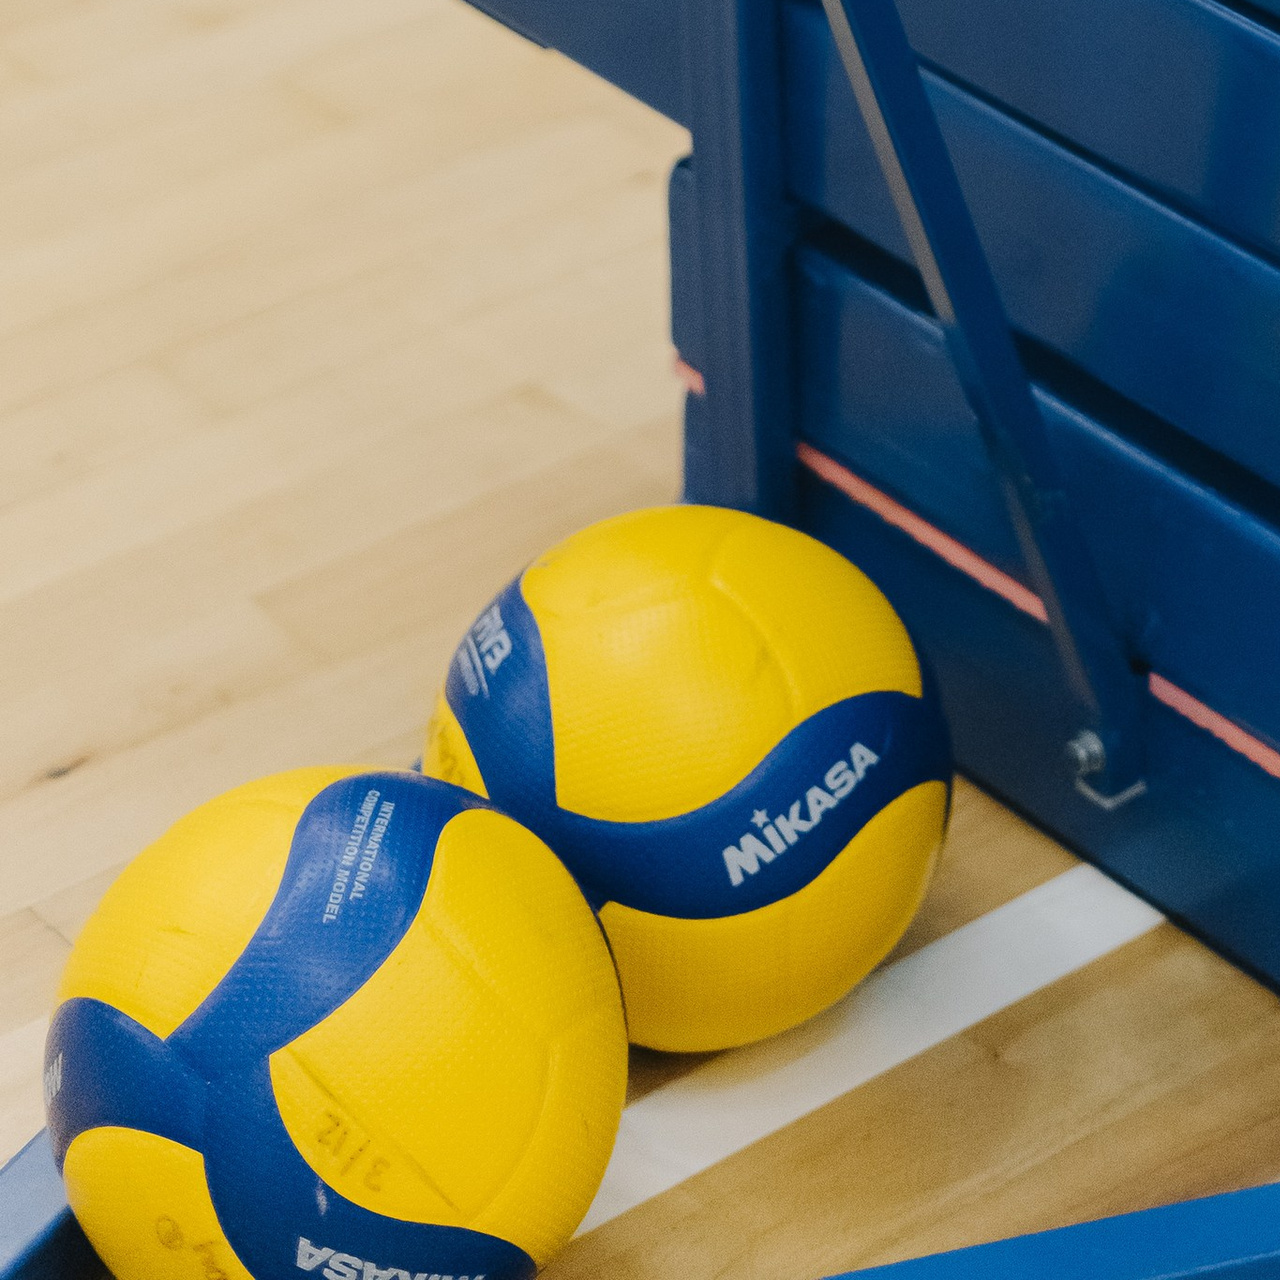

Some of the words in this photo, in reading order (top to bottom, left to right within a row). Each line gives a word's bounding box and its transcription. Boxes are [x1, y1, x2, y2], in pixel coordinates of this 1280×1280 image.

[342, 789, 381, 866] COMPETITION
[350, 801, 396, 900] INTERNATIONAL
[323, 867, 350, 924] MODEL
